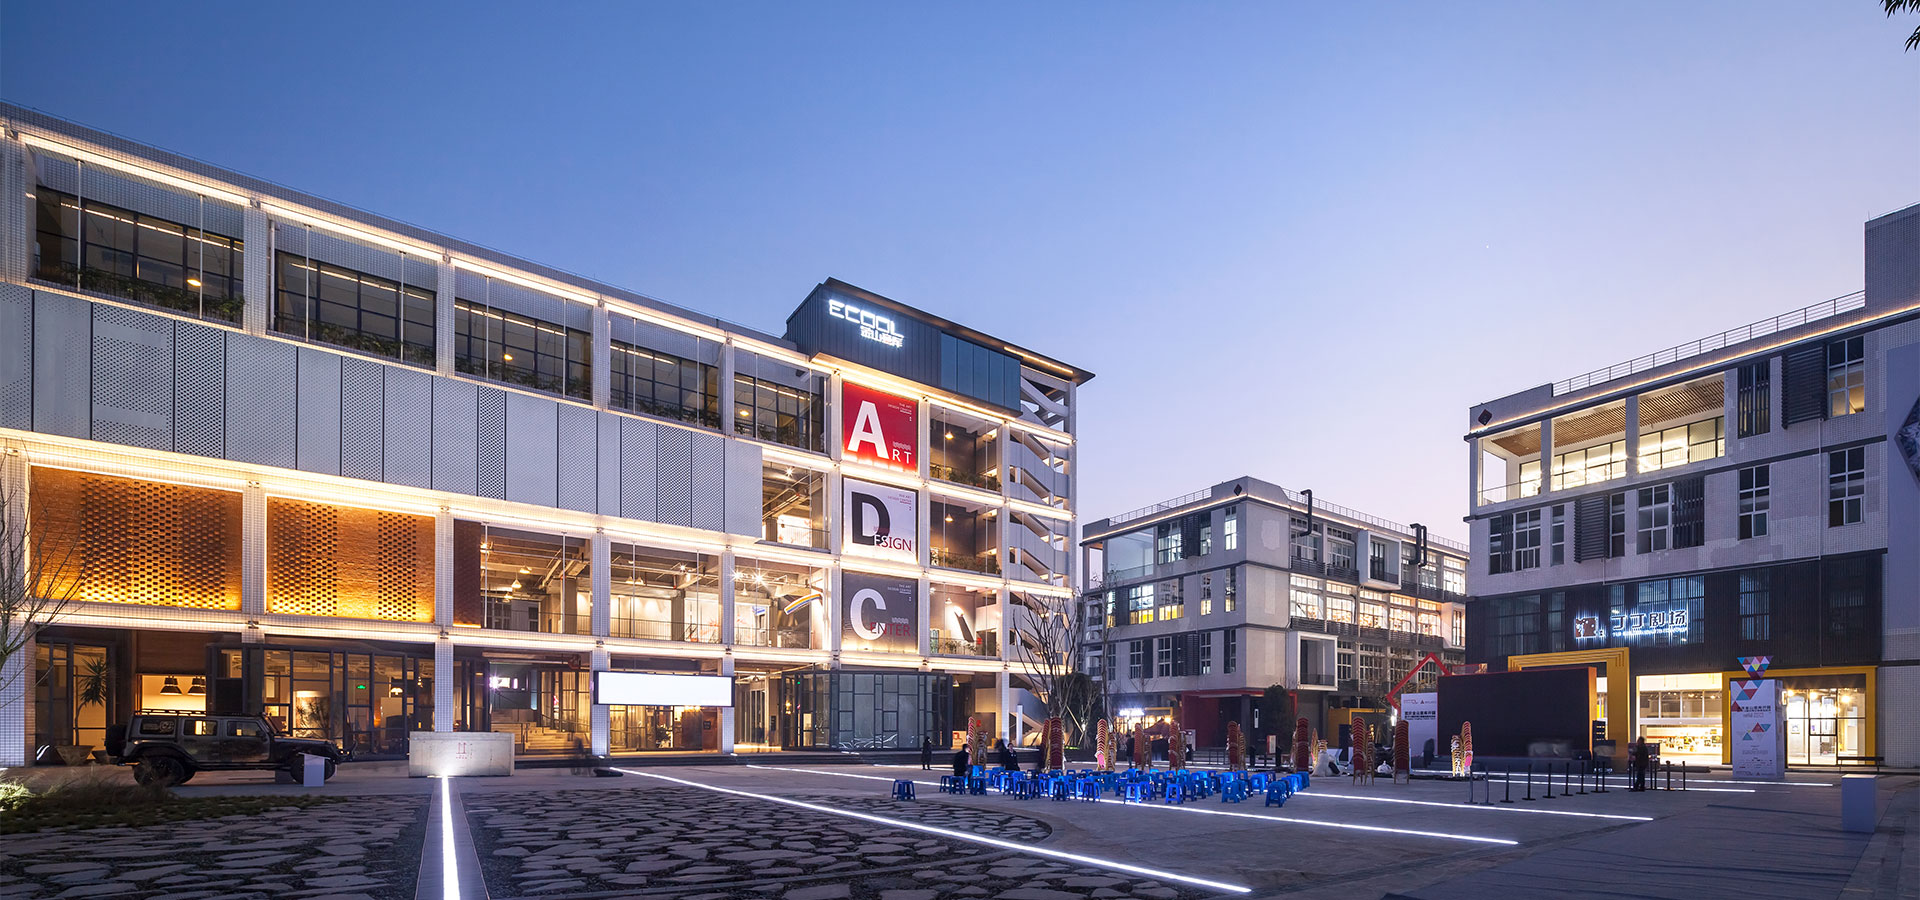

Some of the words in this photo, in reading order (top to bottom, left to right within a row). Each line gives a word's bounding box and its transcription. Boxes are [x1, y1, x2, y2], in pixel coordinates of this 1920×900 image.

[828, 299, 904, 339] ECOOL
[1611, 610, 1687, 631] 丁丁剧场
